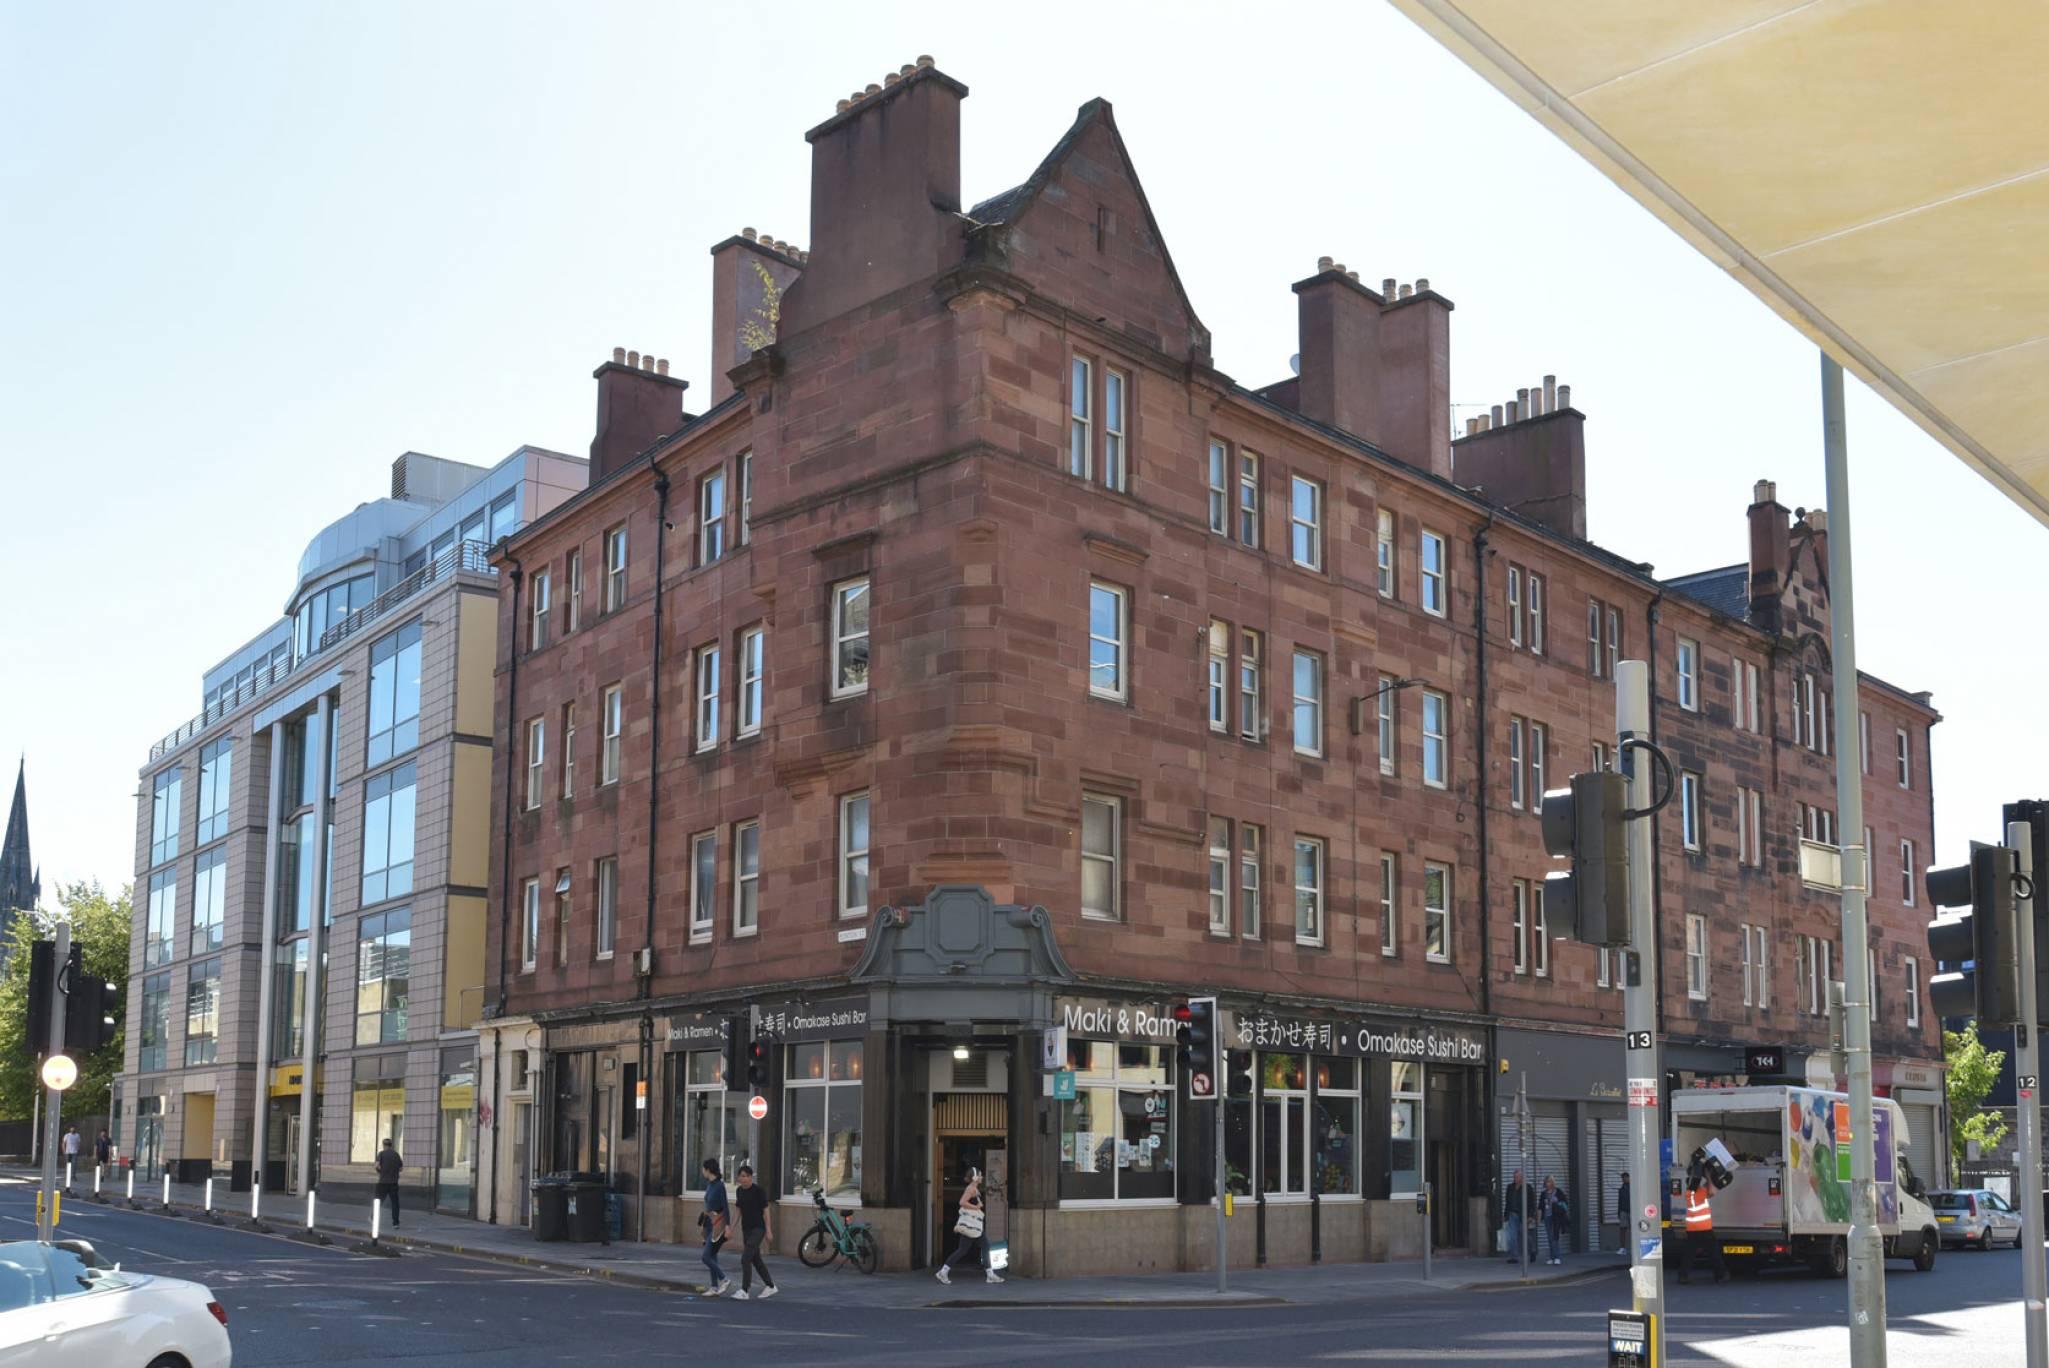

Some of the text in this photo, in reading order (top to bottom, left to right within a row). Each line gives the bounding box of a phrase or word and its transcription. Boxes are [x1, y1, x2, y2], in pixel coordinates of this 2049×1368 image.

[793, 1011, 867, 1030] Omakase Sushi Bar
[1064, 1005, 1192, 1037] Maki & Ram
[690, 1026, 714, 1039] Ramen
[1238, 1017, 1331, 1050] おまかせ寿司
[1629, 1032, 1650, 1048] 13
[1358, 1029, 1482, 1060] Omakase Sushi Bar
[2019, 1077, 2036, 1088] 12
[1615, 1340, 1642, 1353] WAIT
